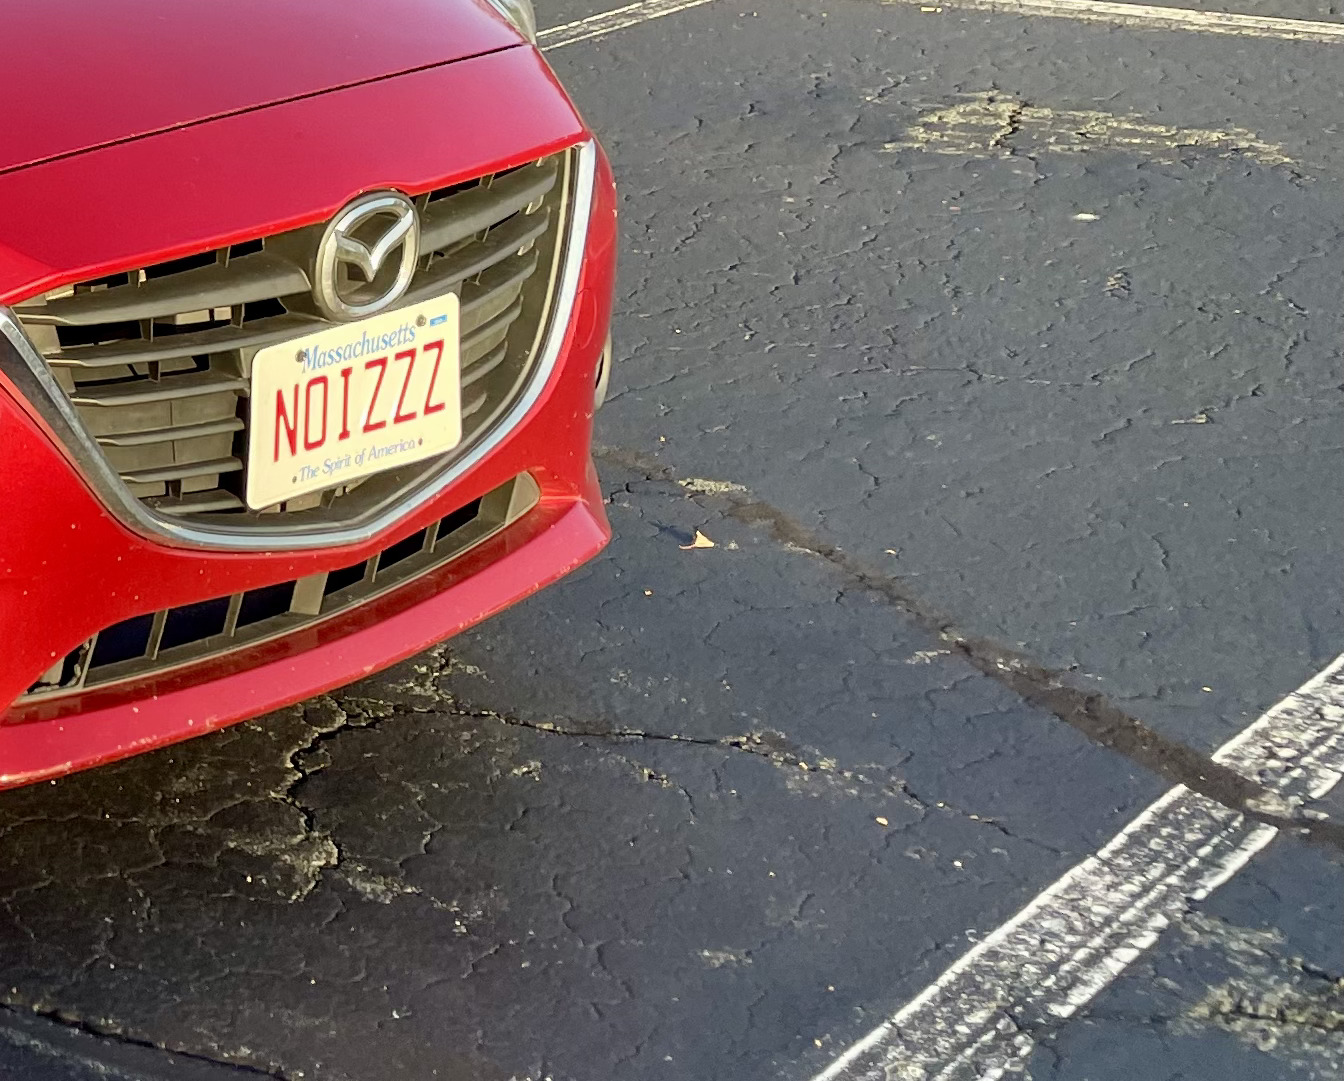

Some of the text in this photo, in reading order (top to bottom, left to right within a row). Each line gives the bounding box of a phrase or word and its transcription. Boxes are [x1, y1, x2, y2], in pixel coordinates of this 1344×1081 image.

[301, 322, 416, 373] Massachusetts
[273, 338, 446, 462] NOIZZZ
[299, 439, 416, 482] The Spirit of America
